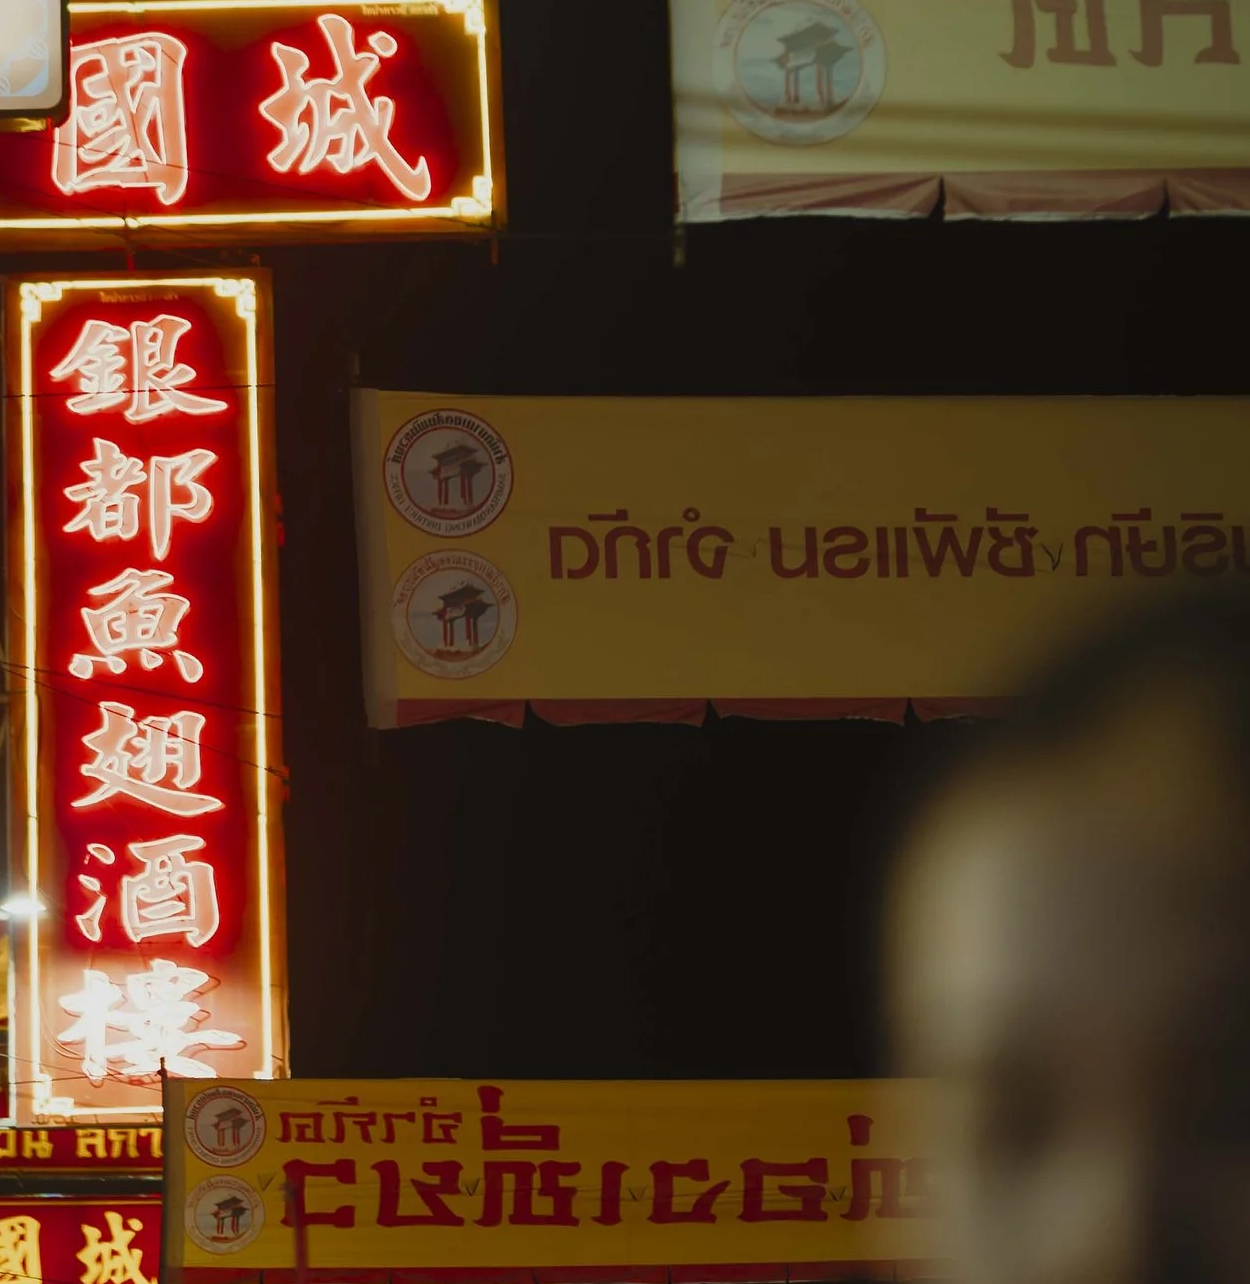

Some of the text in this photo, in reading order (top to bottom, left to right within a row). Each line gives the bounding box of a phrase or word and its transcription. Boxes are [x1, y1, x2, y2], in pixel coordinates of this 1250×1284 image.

[49, 313, 244, 1081] 銀都魚翅酒樓
